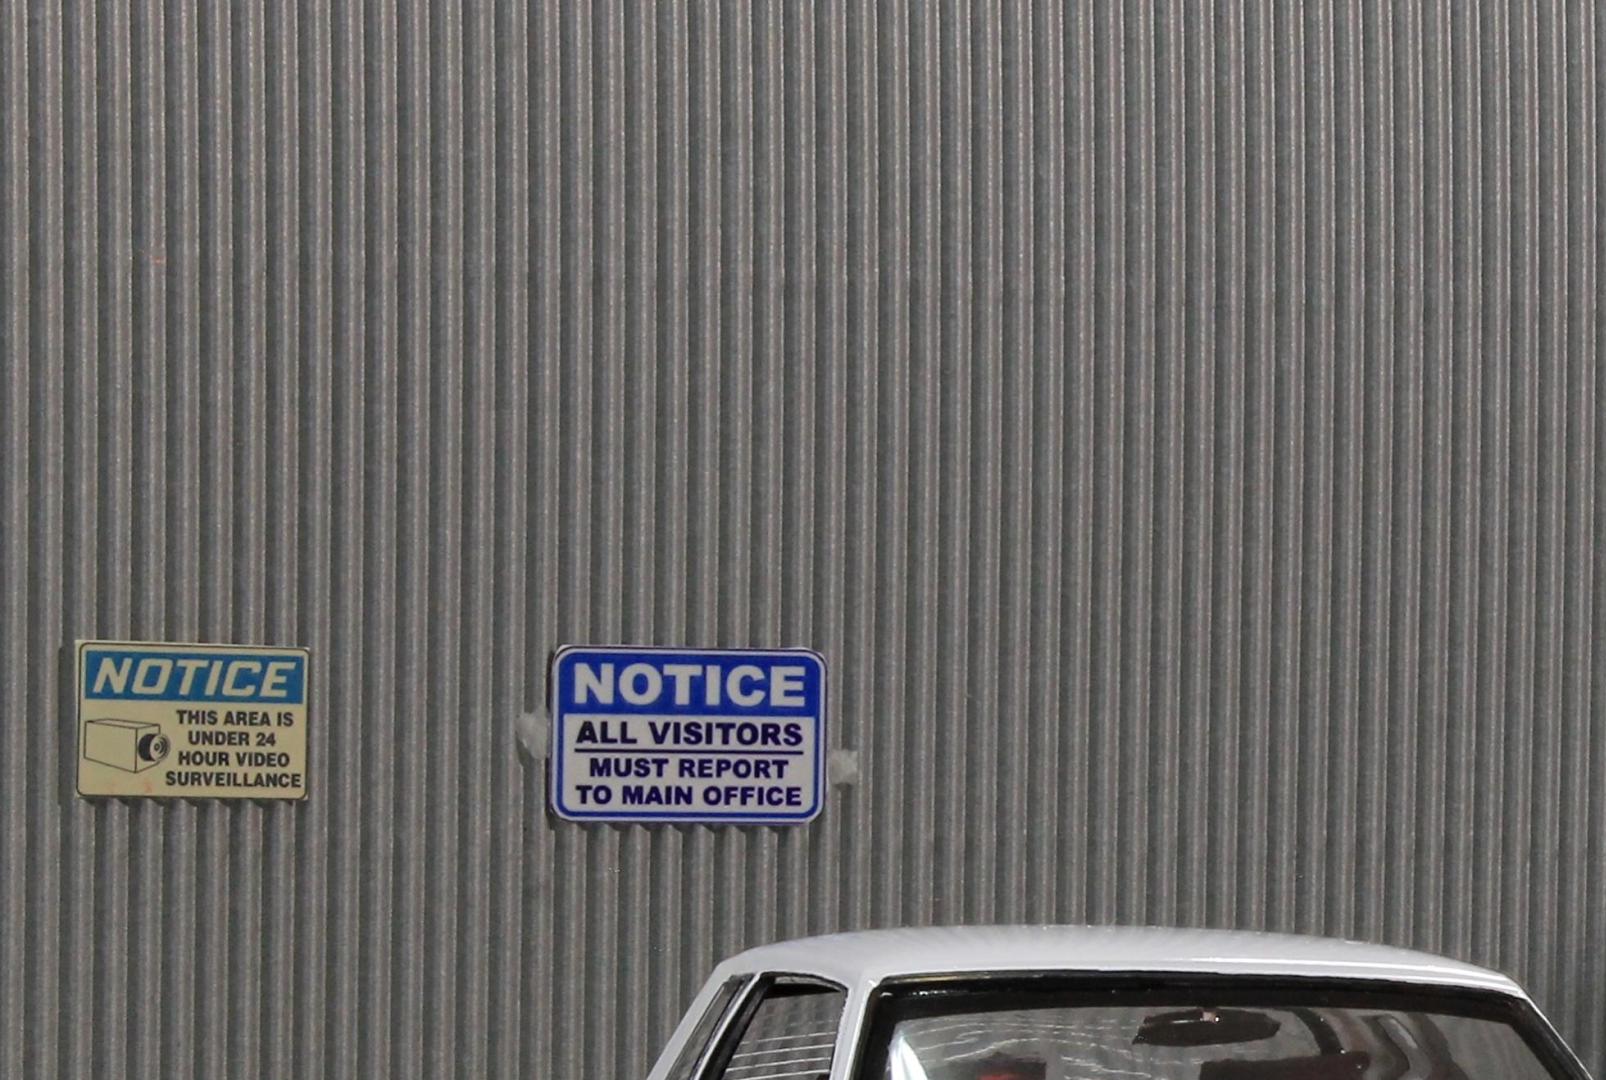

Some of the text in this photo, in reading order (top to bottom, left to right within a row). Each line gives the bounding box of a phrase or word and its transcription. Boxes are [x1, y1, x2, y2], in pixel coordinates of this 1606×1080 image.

[92, 657, 296, 698] NOTICE
[573, 662, 806, 708] NOTICE
[177, 709, 294, 727] THIS AREA IS
[188, 730, 276, 746] UNDER 24
[576, 721, 804, 747] ALL VISITORS
[178, 750, 290, 768] HOUR VIDEO
[589, 757, 789, 779] MUST REPORT
[165, 770, 302, 789] SURVEILLANCE
[575, 785, 802, 806] TO MAIN OFFICE
